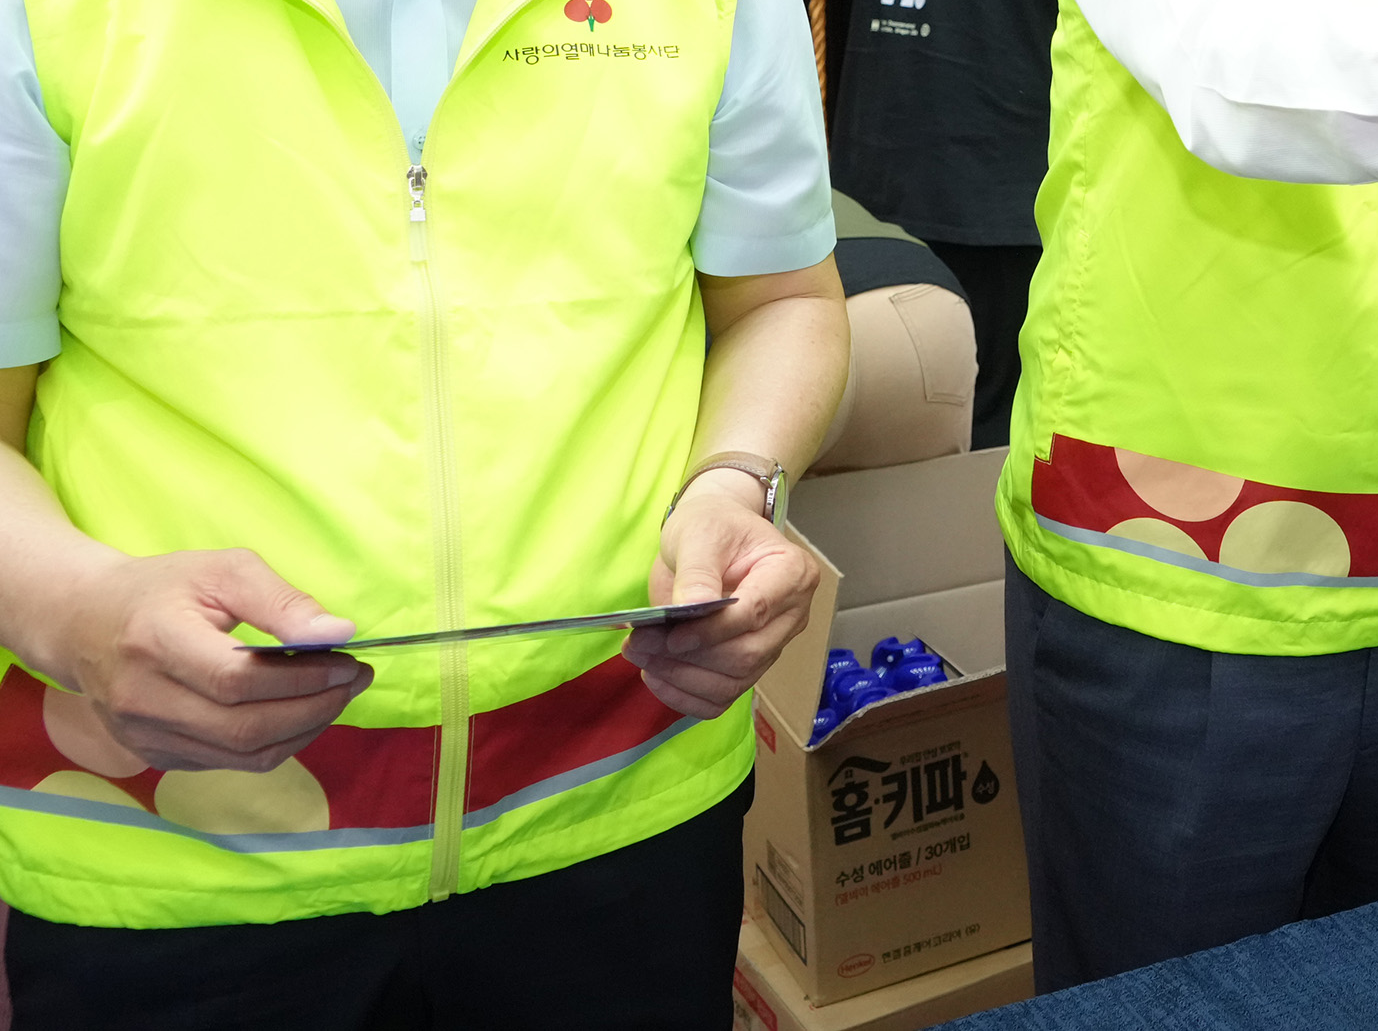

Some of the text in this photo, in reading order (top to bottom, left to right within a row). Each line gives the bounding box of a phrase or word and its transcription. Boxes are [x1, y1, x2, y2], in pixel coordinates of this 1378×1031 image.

[836, 865, 864, 887] 수성
[868, 852, 912, 876] 에어졸
[925, 833, 971, 861] 30개입
